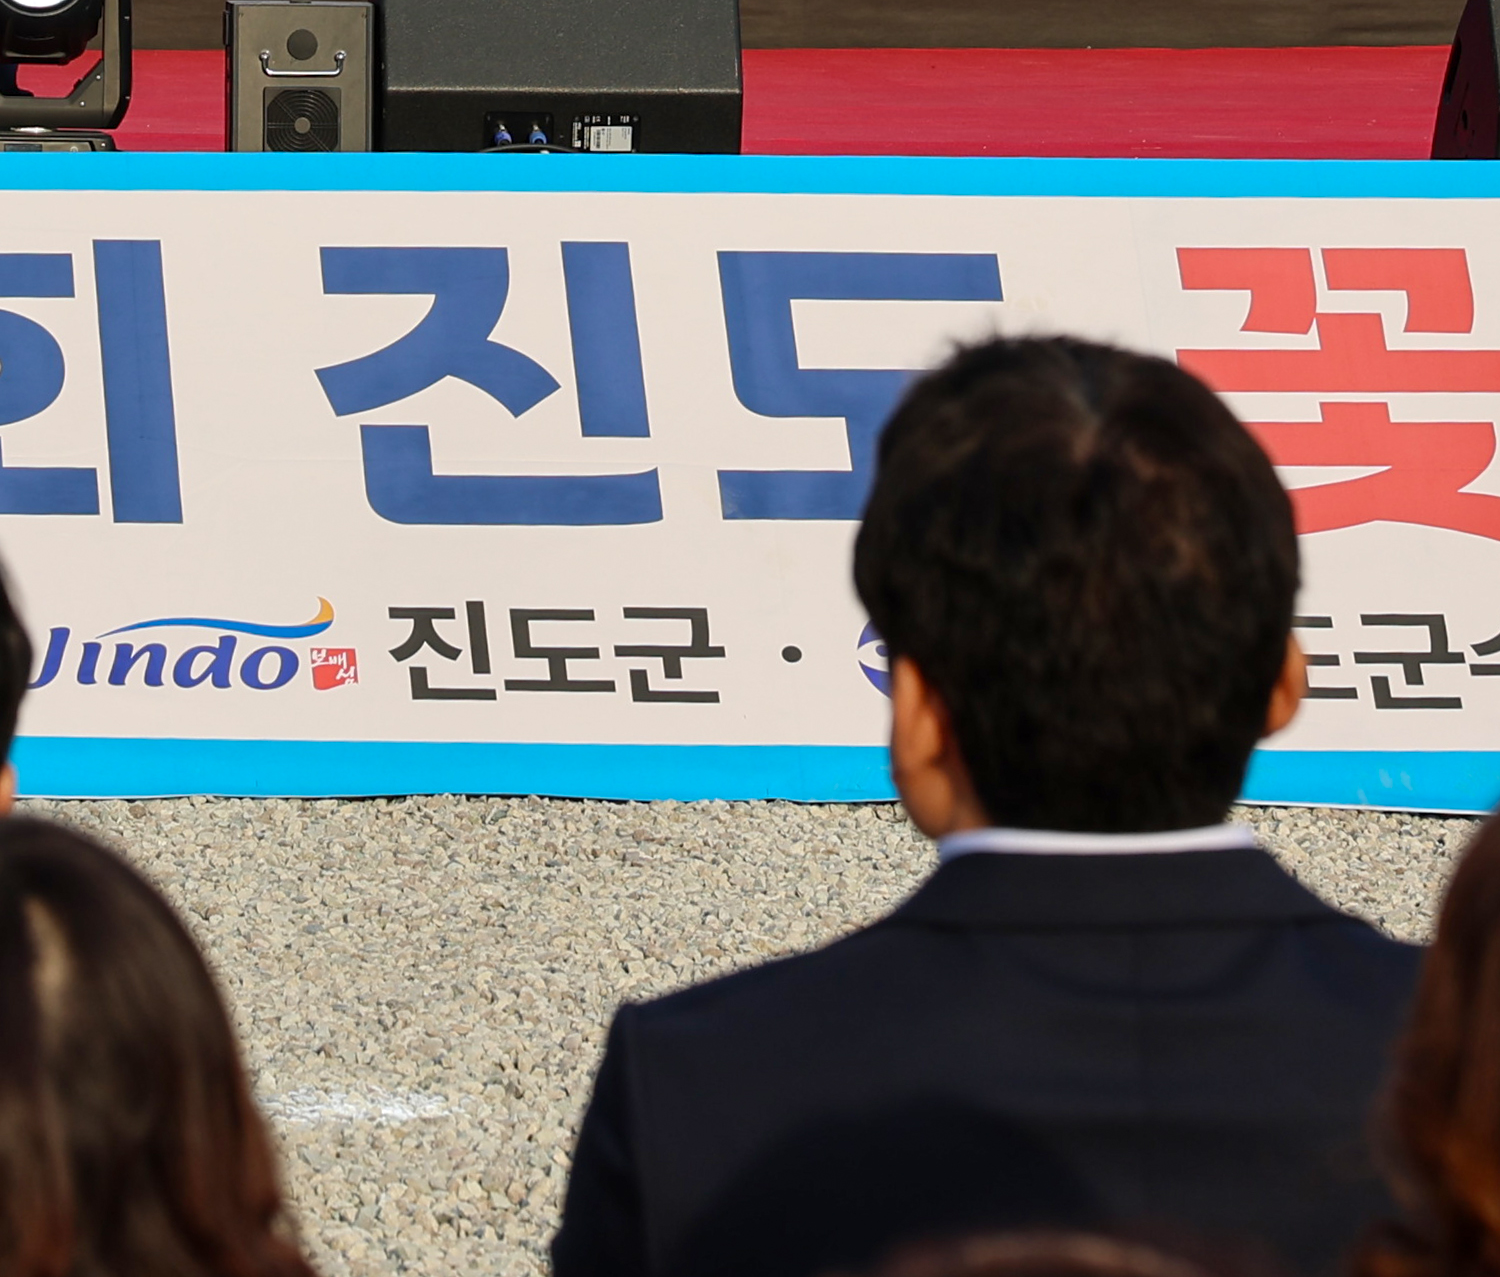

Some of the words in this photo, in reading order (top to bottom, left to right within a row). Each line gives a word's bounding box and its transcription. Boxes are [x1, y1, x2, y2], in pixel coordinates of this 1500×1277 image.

[315, 240, 1004, 526] 진도
[27, 626, 300, 691] Jindo
[386, 600, 727, 705] 진도군
